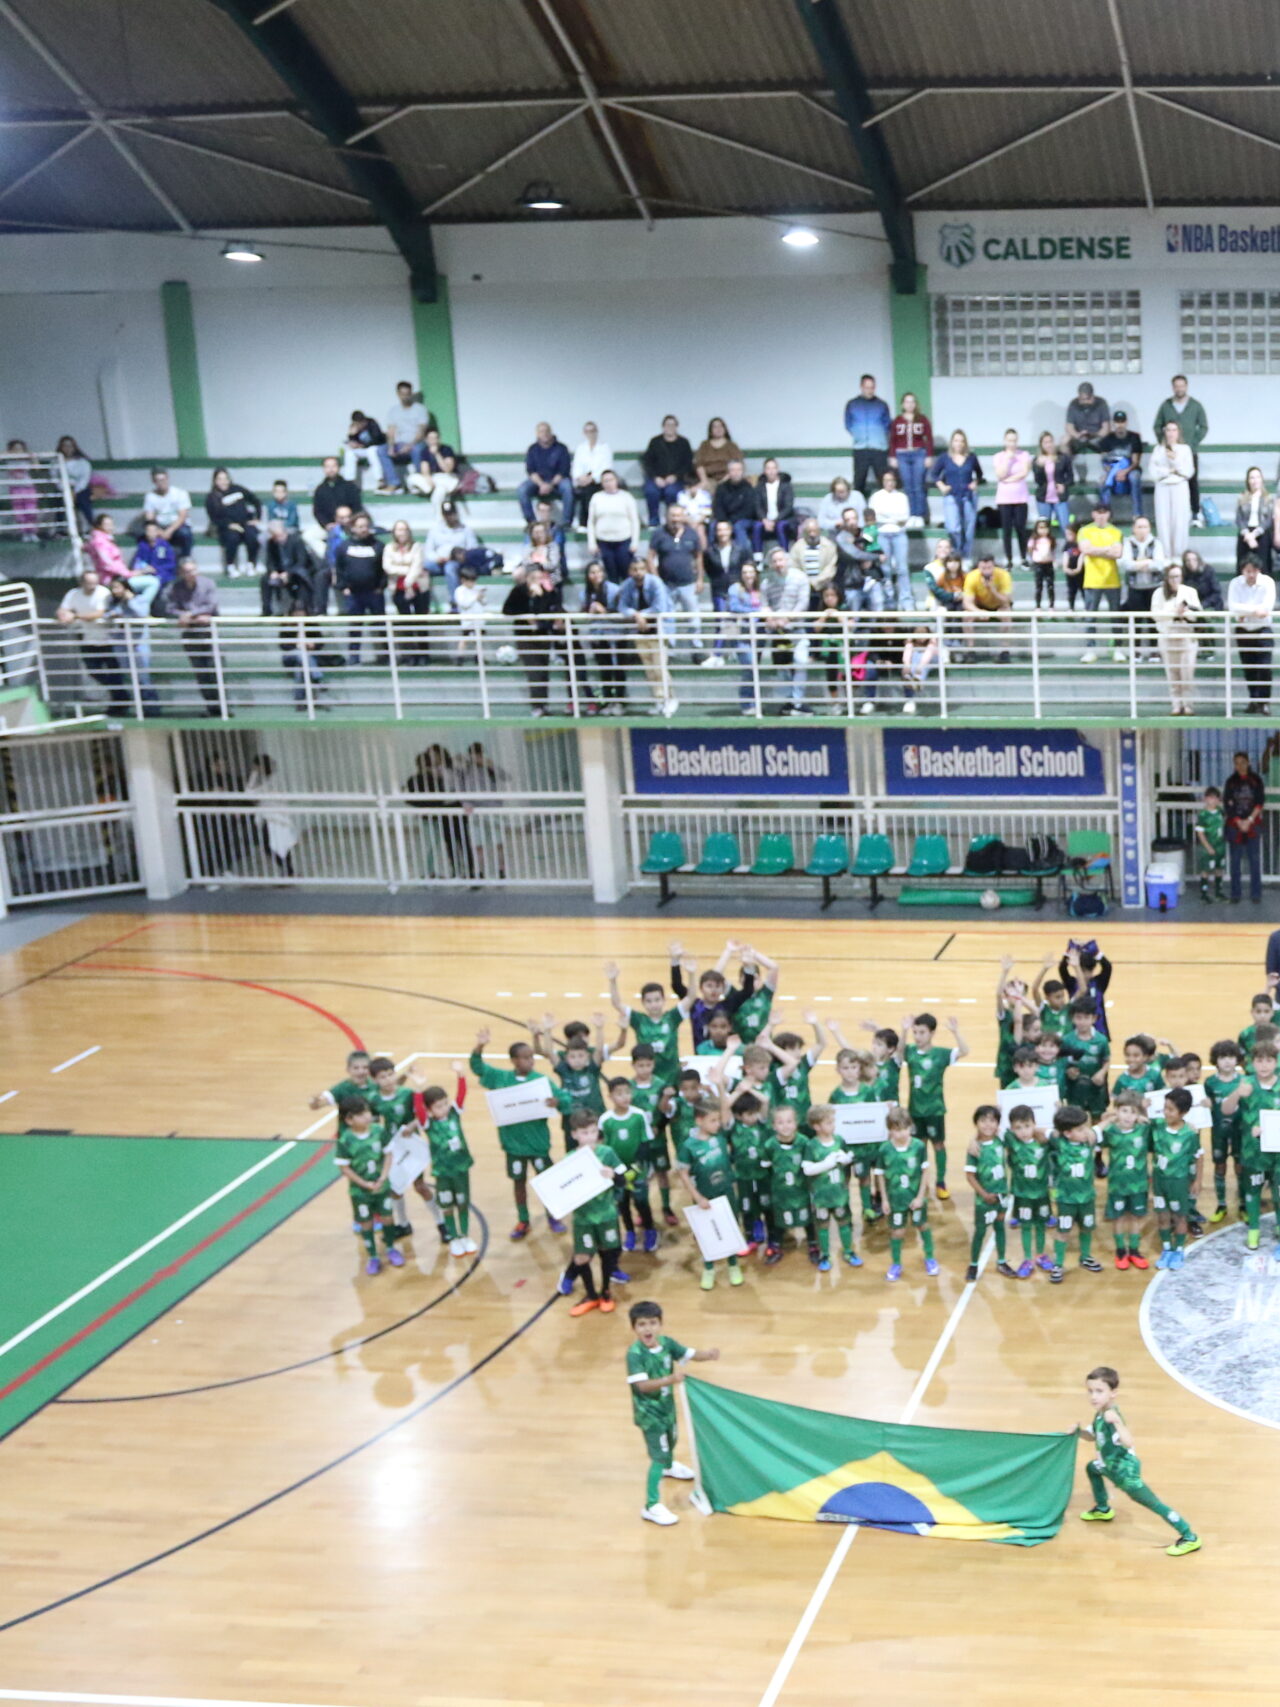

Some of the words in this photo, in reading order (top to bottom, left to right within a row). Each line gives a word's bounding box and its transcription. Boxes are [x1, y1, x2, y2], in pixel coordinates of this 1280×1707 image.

[983, 236, 1131, 261] CALDENSE
[1181, 224, 1214, 252] NBA
[666, 744, 763, 777] Basketball
[765, 744, 830, 777] School
[919, 745, 1017, 777] Basketball
[1020, 745, 1084, 777] School
[1070, 1163, 1085, 1177] 10
